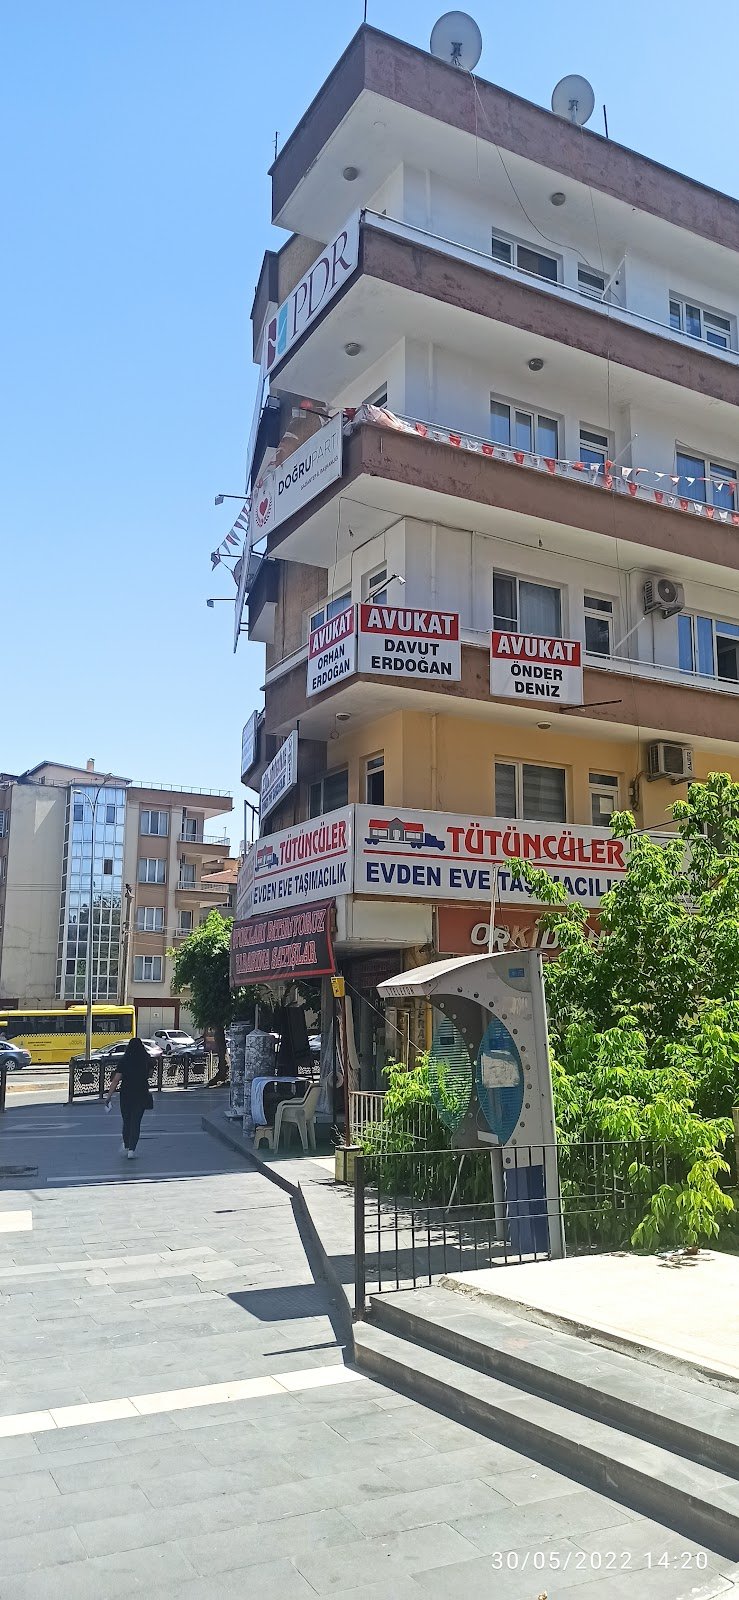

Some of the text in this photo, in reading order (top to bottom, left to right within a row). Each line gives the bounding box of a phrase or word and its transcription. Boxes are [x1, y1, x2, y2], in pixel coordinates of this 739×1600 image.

[290, 230, 352, 340] PDR
[311, 609, 353, 654] AVUKAT
[367, 608, 455, 636] AVUKAT
[317, 643, 346, 671] ORHAN
[384, 638, 440, 657] DAVUT
[497, 635, 576, 662] AVUKAT
[312, 657, 350, 691] ERDOĞAN
[371, 655, 452, 676] ERDOĞAN
[510, 662, 563, 682] ÖNDER
[514, 680, 561, 698] DENİZ
[279, 820, 347, 866] TÜTÜNCÜLER
[446, 821, 626, 869] TÜTÜNCÜLER
[253, 861, 347, 905] EVDEN EVE TAŞIMACILIK
[366, 861, 441, 887] EVDEN
[449, 867, 491, 891] EVE
[470, 918, 571, 951] ORKİD
